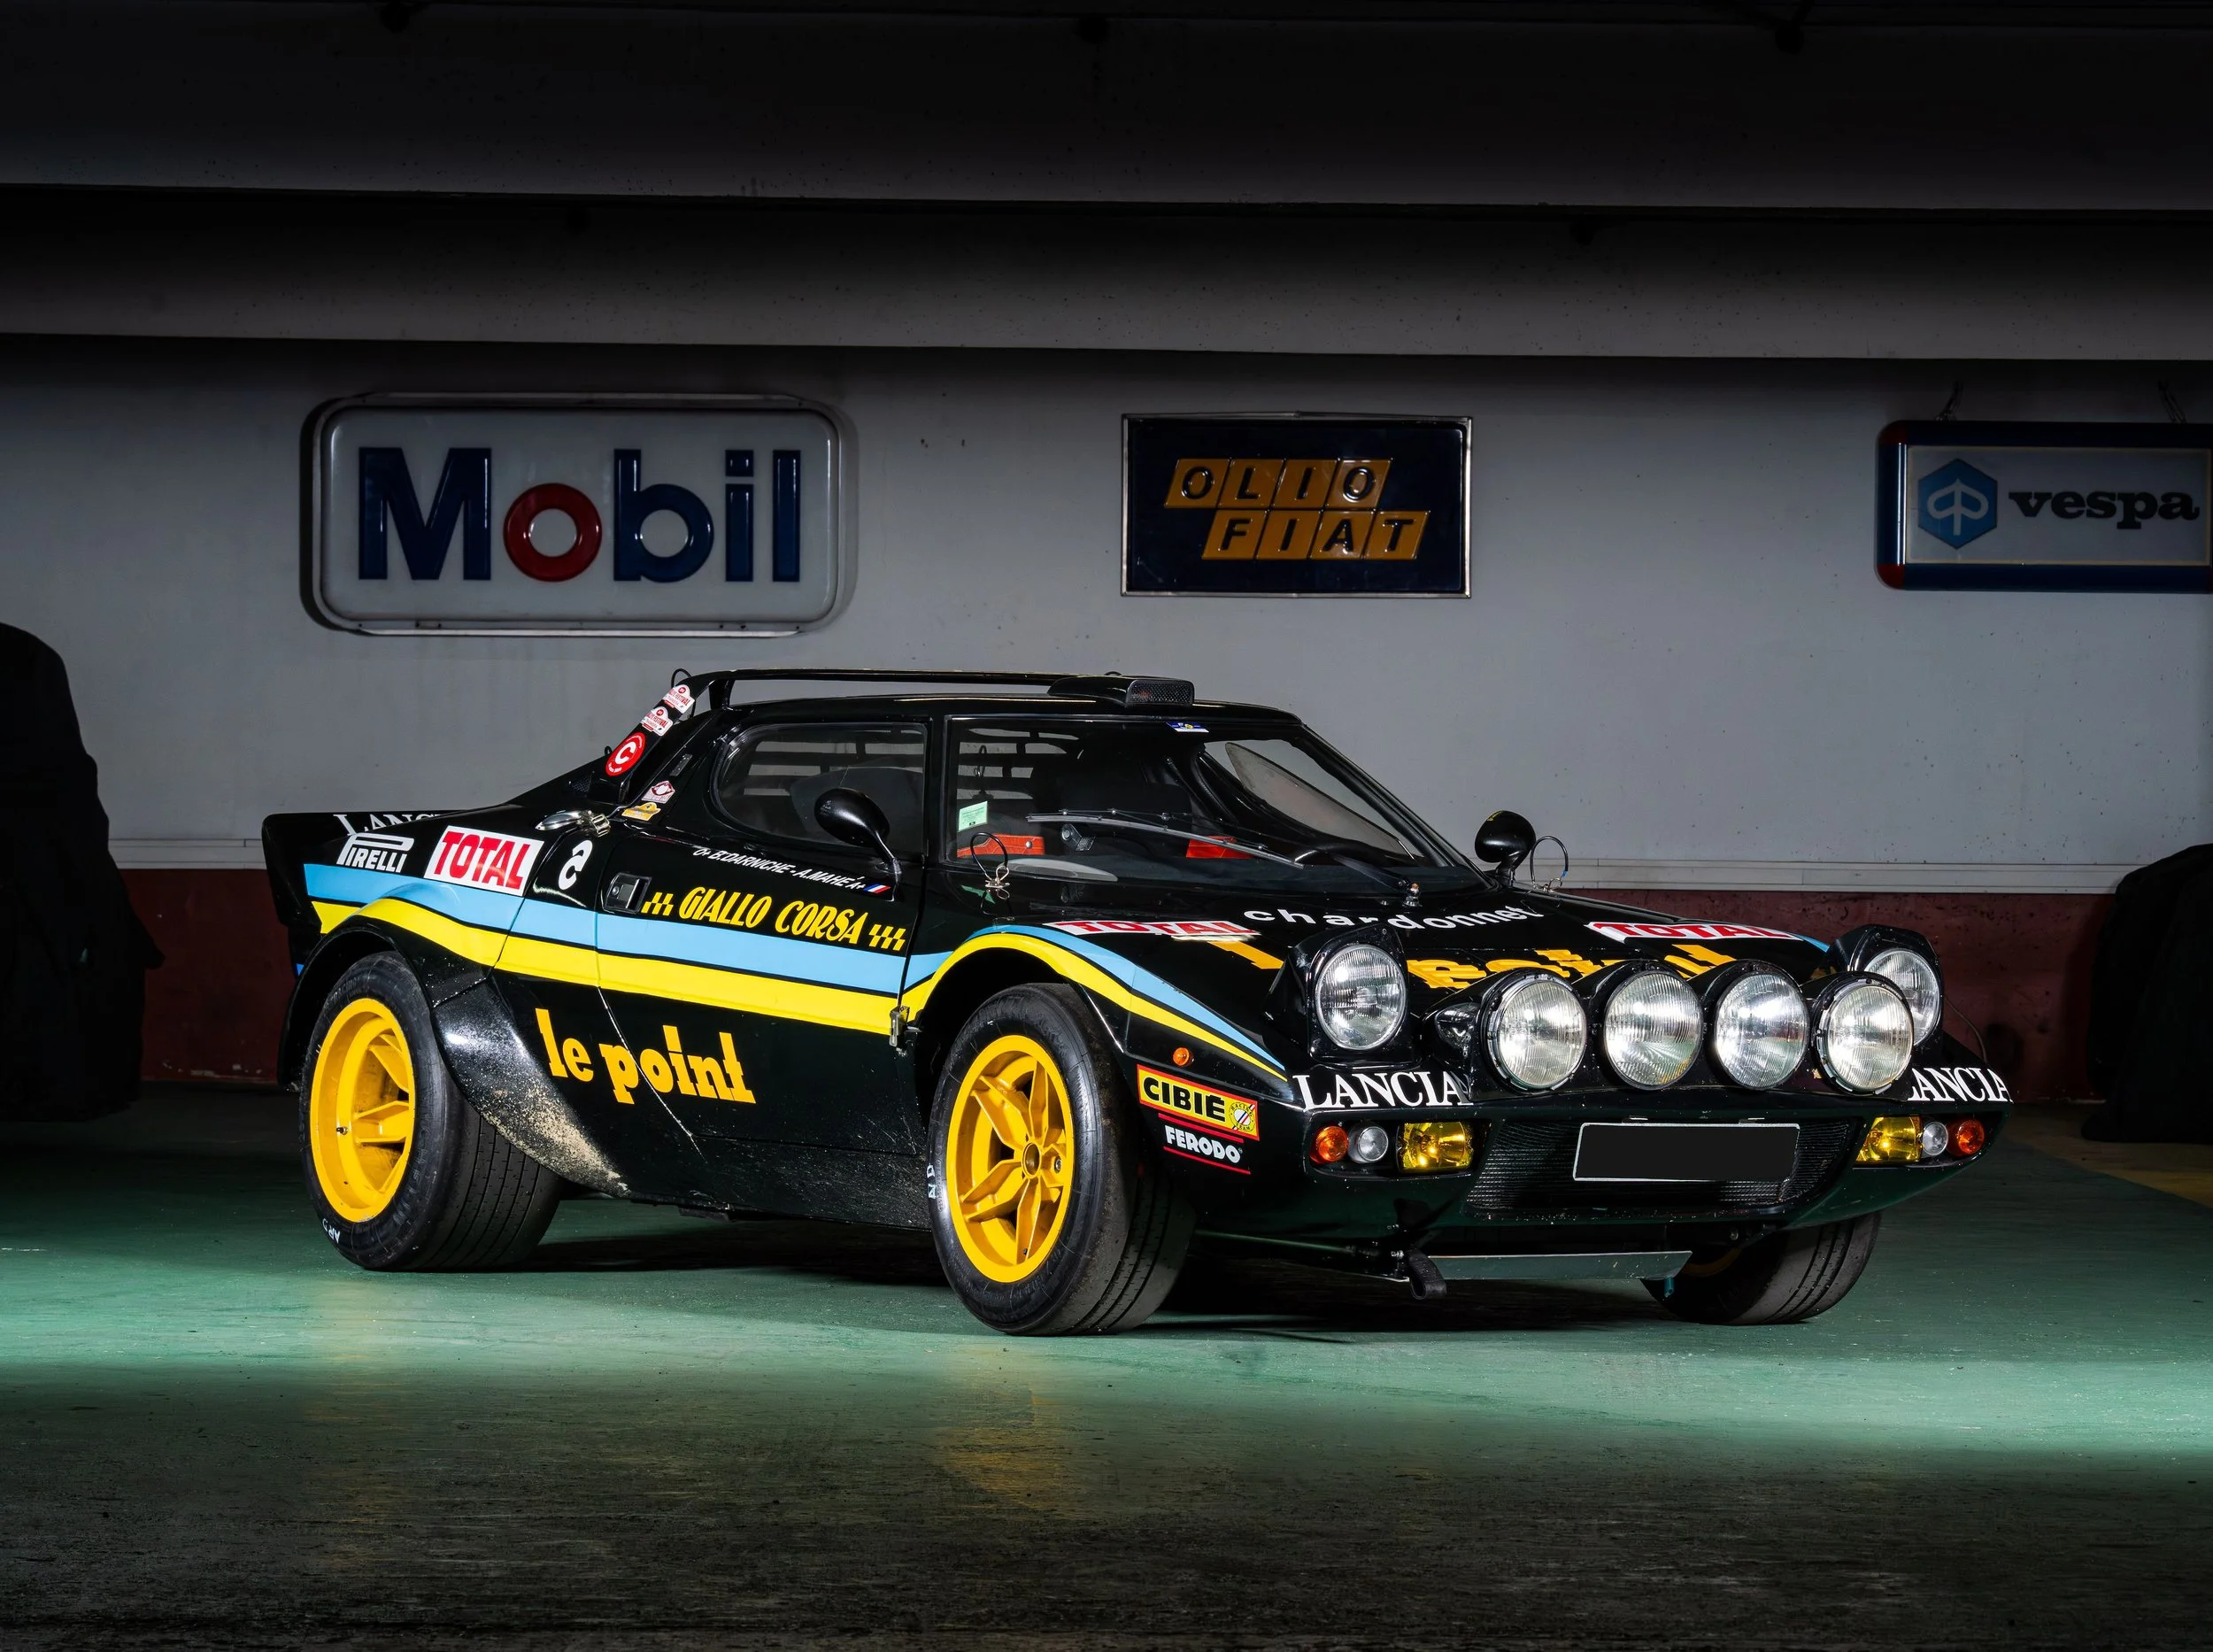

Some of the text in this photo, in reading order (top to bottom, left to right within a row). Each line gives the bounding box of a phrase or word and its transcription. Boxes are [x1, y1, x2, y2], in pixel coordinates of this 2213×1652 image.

[1180, 465, 1375, 503] OLIO
[359, 446, 801, 583] Mobil
[2008, 490, 2200, 530] vespa
[1217, 517, 1415, 554] FIAT
[335, 832, 415, 874] PIRELLI
[434, 830, 531, 891] TOTAL
[679, 886, 868, 945] GIALLO CORSA
[1054, 920, 1259, 935] TOTAL
[1243, 904, 1545, 930] chardonnet
[1592, 922, 1792, 938] TOTAL
[535, 1007, 757, 1105] le point
[1292, 1070, 1475, 1113] LANCIA
[1164, 1124, 1241, 1164] FERODO
